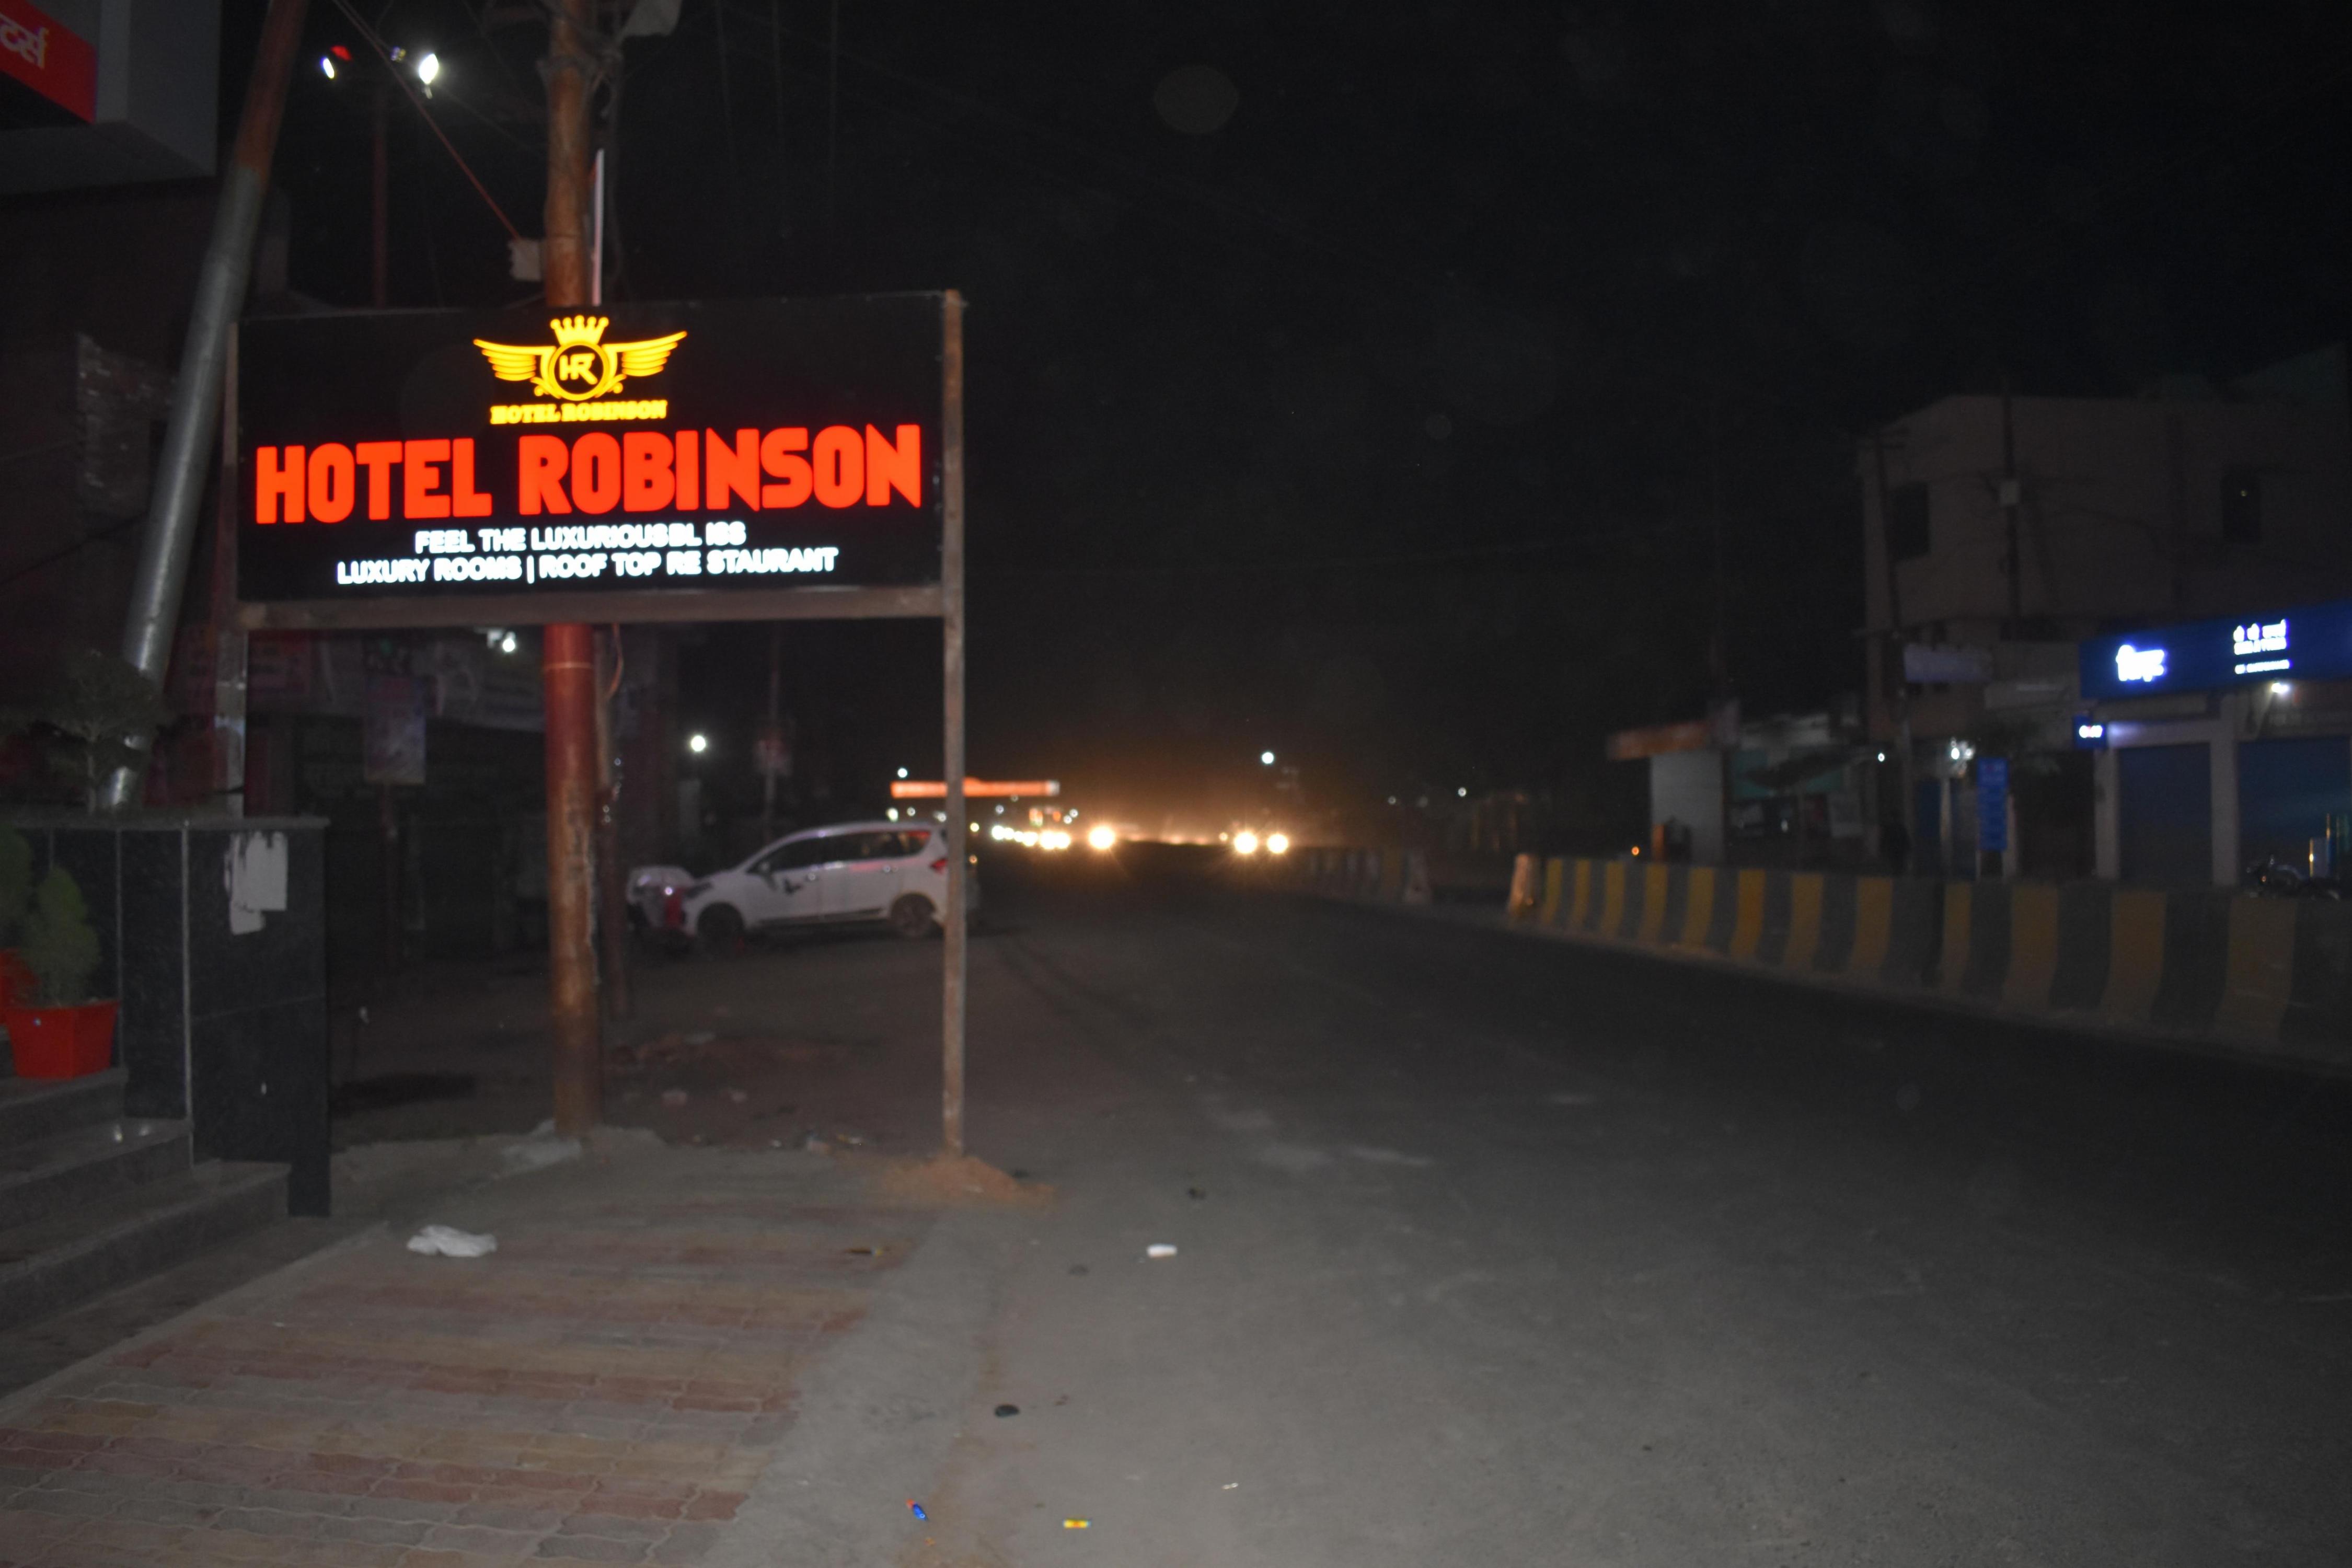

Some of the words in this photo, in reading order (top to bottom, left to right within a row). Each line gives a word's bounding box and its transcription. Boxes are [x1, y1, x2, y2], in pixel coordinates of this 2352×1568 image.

[490, 402, 561, 424] HOTEL
[562, 400, 668, 422] ROBINSON
[256, 438, 492, 524] HOTEL
[518, 424, 921, 515] ROBINSON
[416, 530, 475, 554] FEEL
[478, 528, 526, 551] THE
[338, 559, 430, 584] LUXURY
[434, 556, 522, 581] ROOMS
[539, 553, 607, 578] ROOF
[611, 552, 661, 576] TOP
